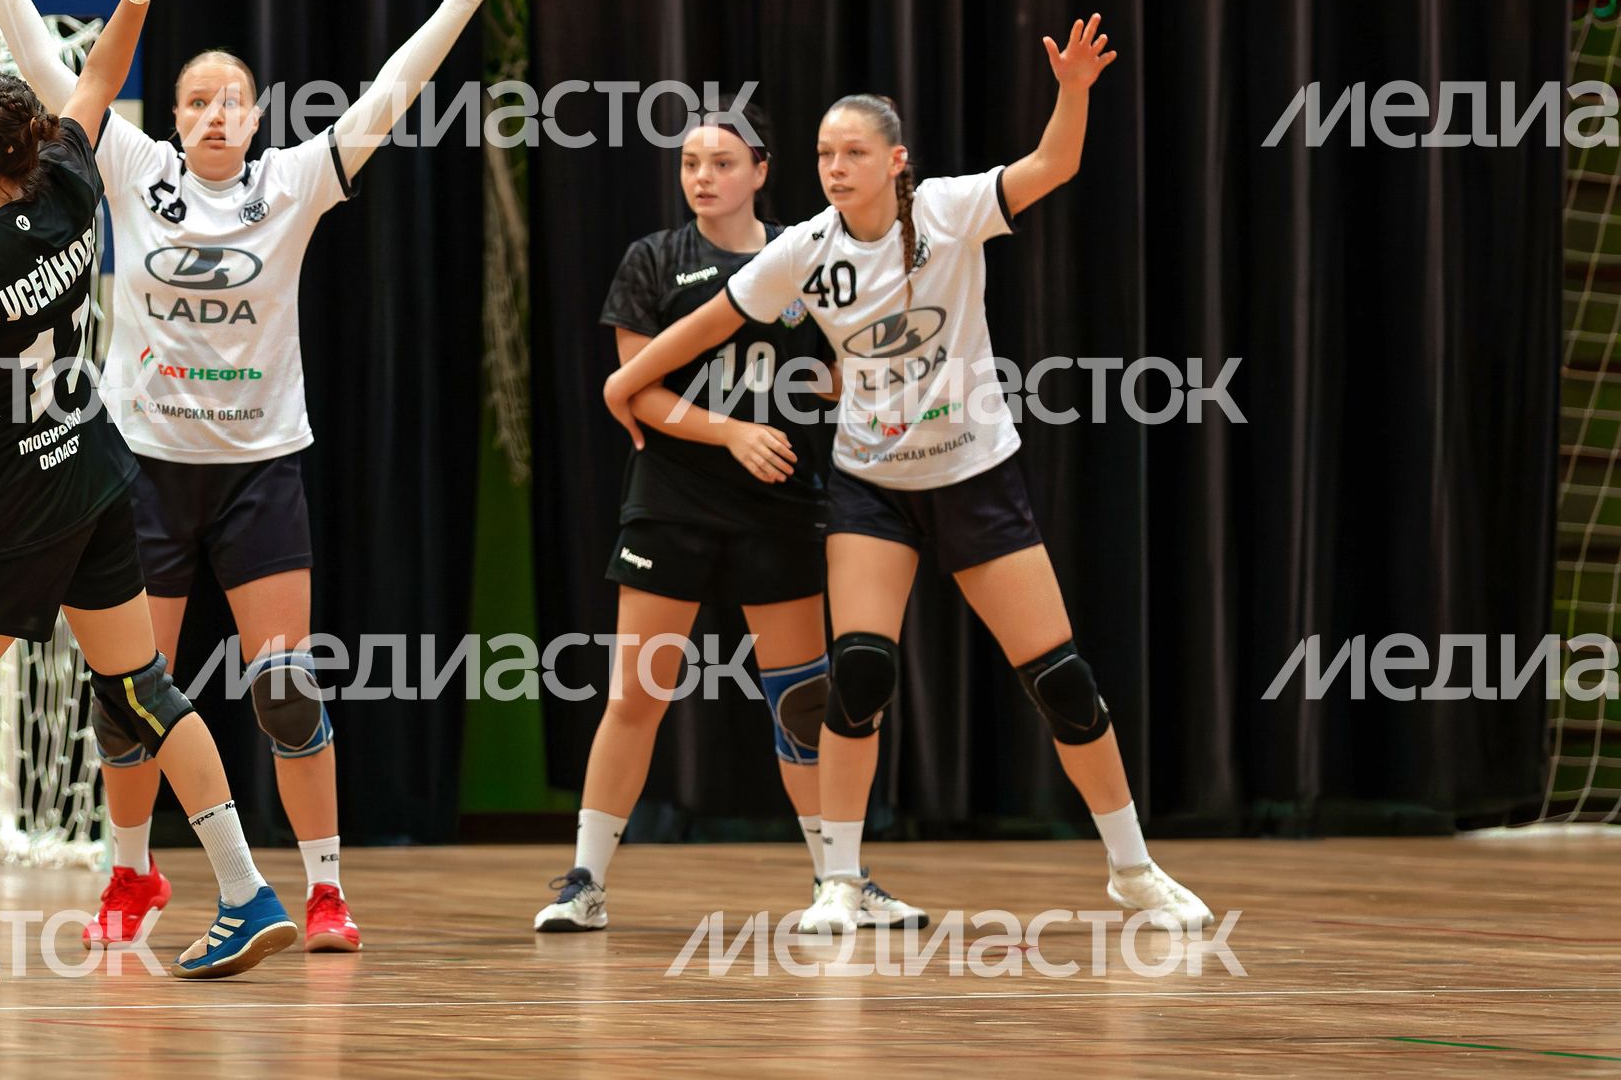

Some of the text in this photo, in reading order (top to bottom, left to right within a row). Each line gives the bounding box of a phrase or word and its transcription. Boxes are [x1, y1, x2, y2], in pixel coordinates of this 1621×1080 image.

[676, 266, 719, 285] Kempa
[803, 260, 857, 308] 40
[145, 293, 257, 324] LADA
[717, 341, 776, 393] 10
[860, 345, 947, 391] LADA
[39, 433, 80, 470] ОБЛАСТ
